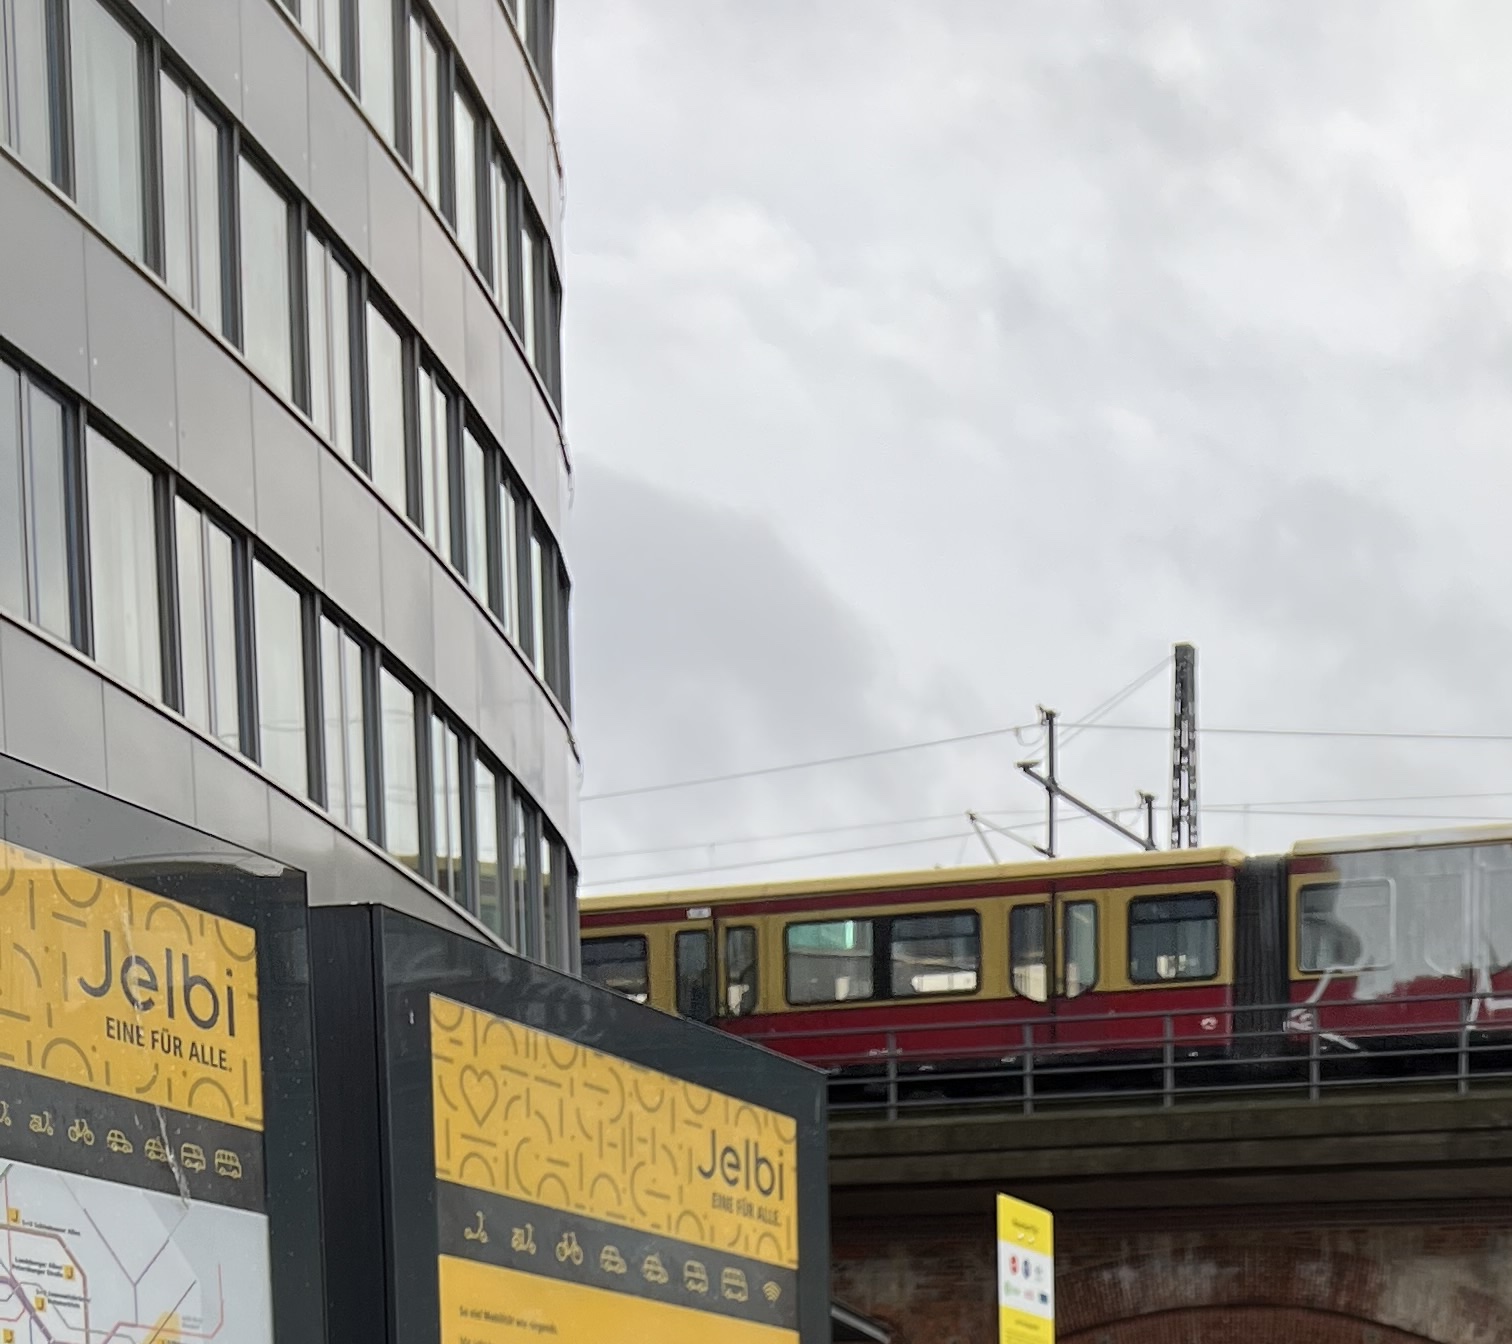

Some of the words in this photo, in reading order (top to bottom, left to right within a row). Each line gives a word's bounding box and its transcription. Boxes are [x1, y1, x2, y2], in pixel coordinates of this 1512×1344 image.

[78, 929, 235, 1037] Jelbi
[105, 1016, 145, 1047] EINE
[151, 1028, 183, 1058] FÜR
[188, 1041, 233, 1073] ALLE.
[697, 1129, 784, 1201] Jelbi
